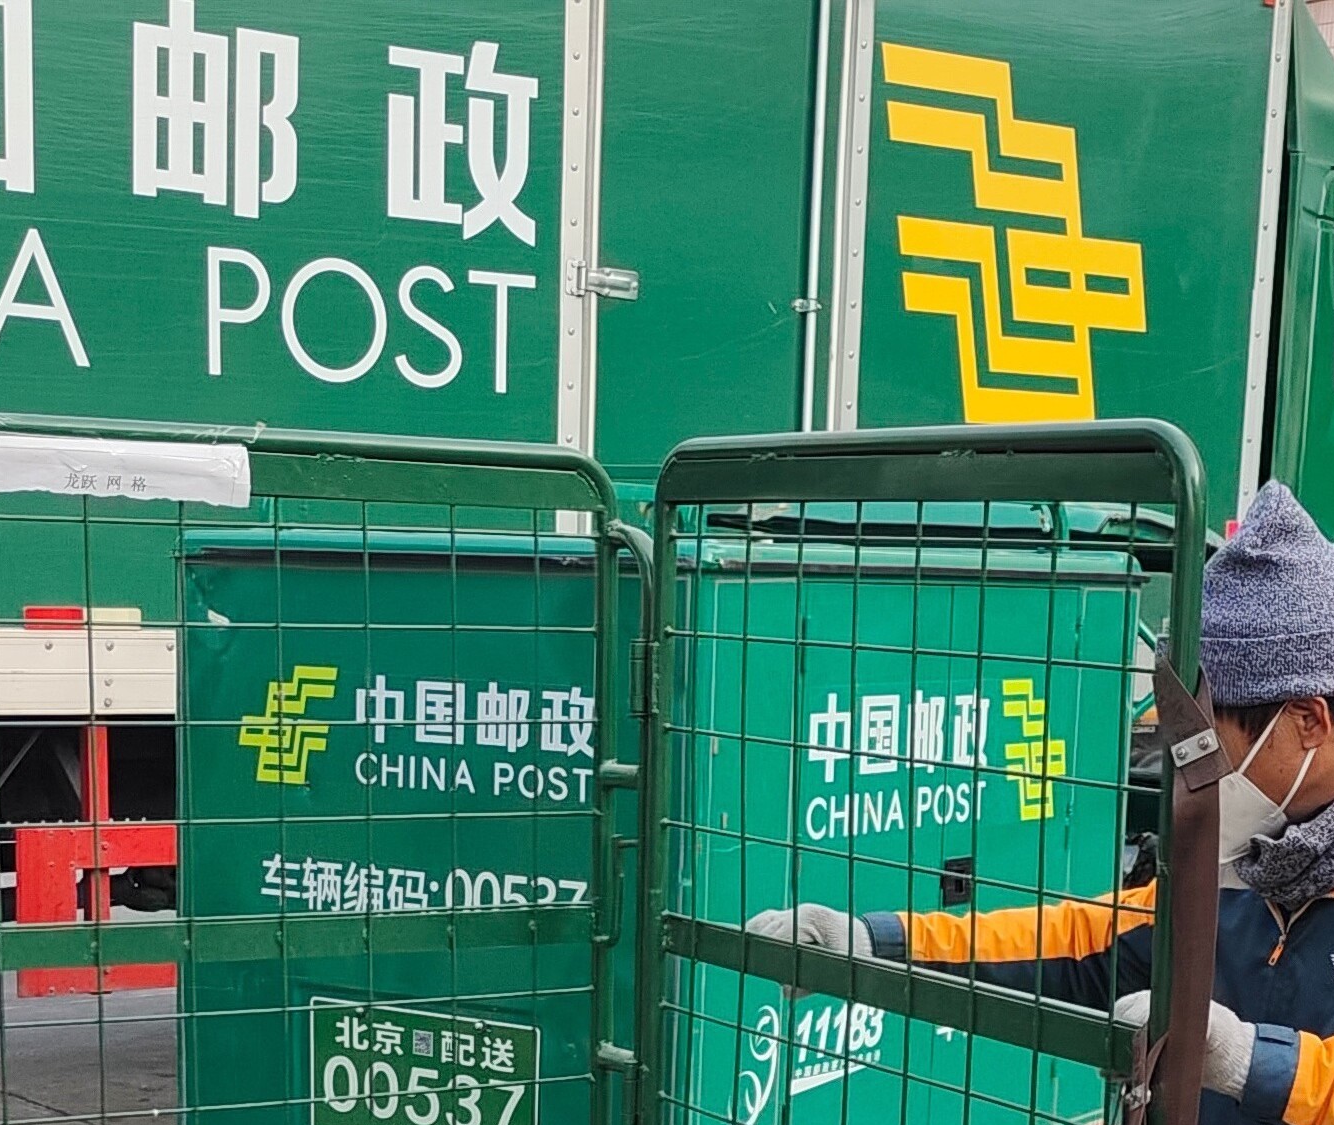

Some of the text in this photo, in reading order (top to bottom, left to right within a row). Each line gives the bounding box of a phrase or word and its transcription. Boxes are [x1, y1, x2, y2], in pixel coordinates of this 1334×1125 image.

[207, 246, 536, 394] POST
[354, 675, 596, 758] 中国邮政
[807, 688, 991, 784] 中国邮政
[354, 751, 593, 804] CHINA POST
[806, 780, 987, 841] CHINA POST
[335, 1015, 515, 1074] 北京 配送
